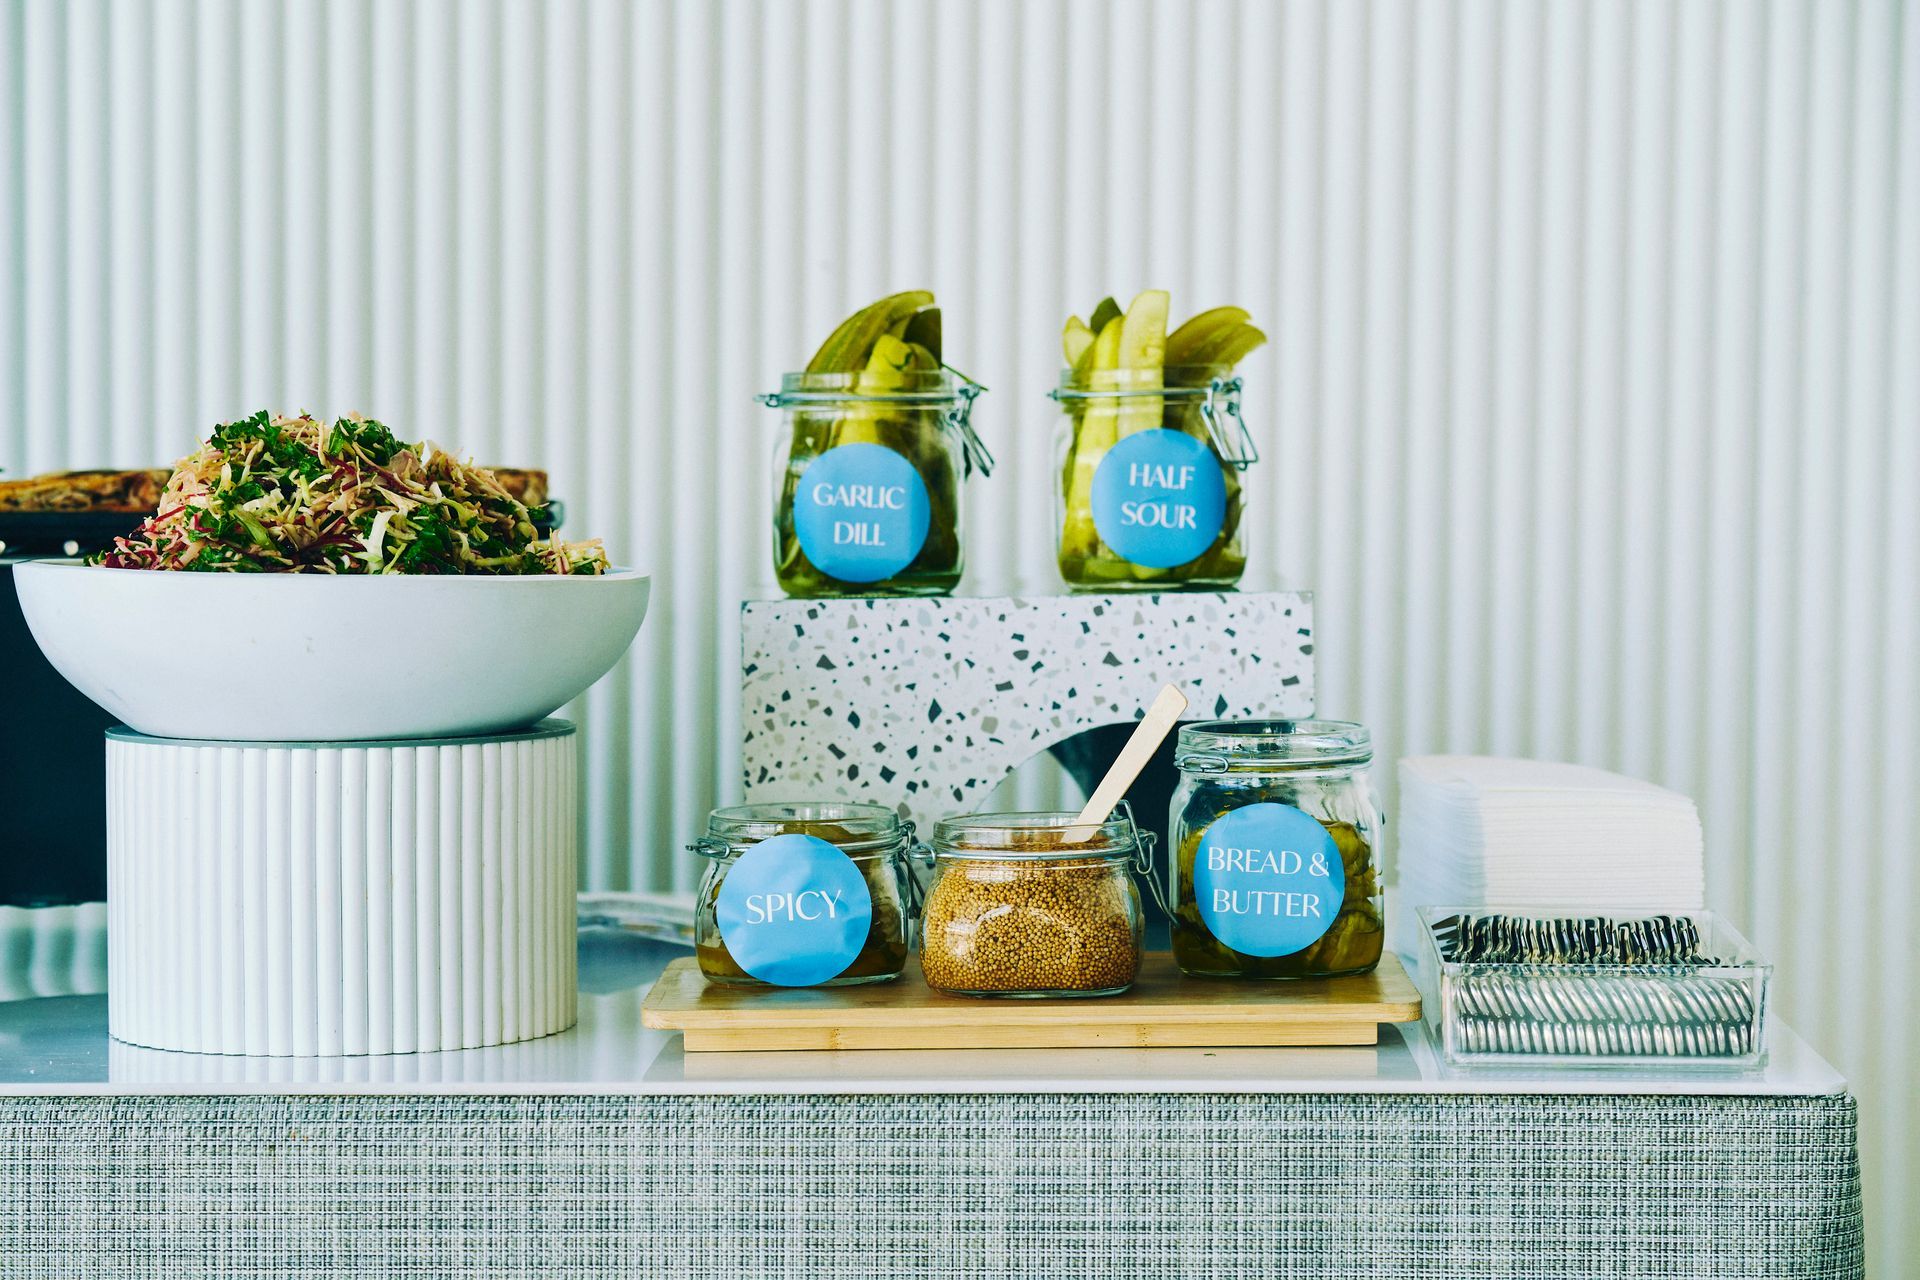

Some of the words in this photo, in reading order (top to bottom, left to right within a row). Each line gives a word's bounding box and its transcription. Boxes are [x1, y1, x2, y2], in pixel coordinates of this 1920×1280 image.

[1129, 462, 1196, 490] HALF
[812, 482, 905, 510] GARLIC
[1120, 501, 1198, 530] SOUR
[833, 520, 886, 547] DILL
[1207, 846, 1303, 877] BREAD
[1307, 850, 1330, 877] &
[744, 887, 842, 925] SPICY
[1211, 887, 1322, 919] BUTTER
